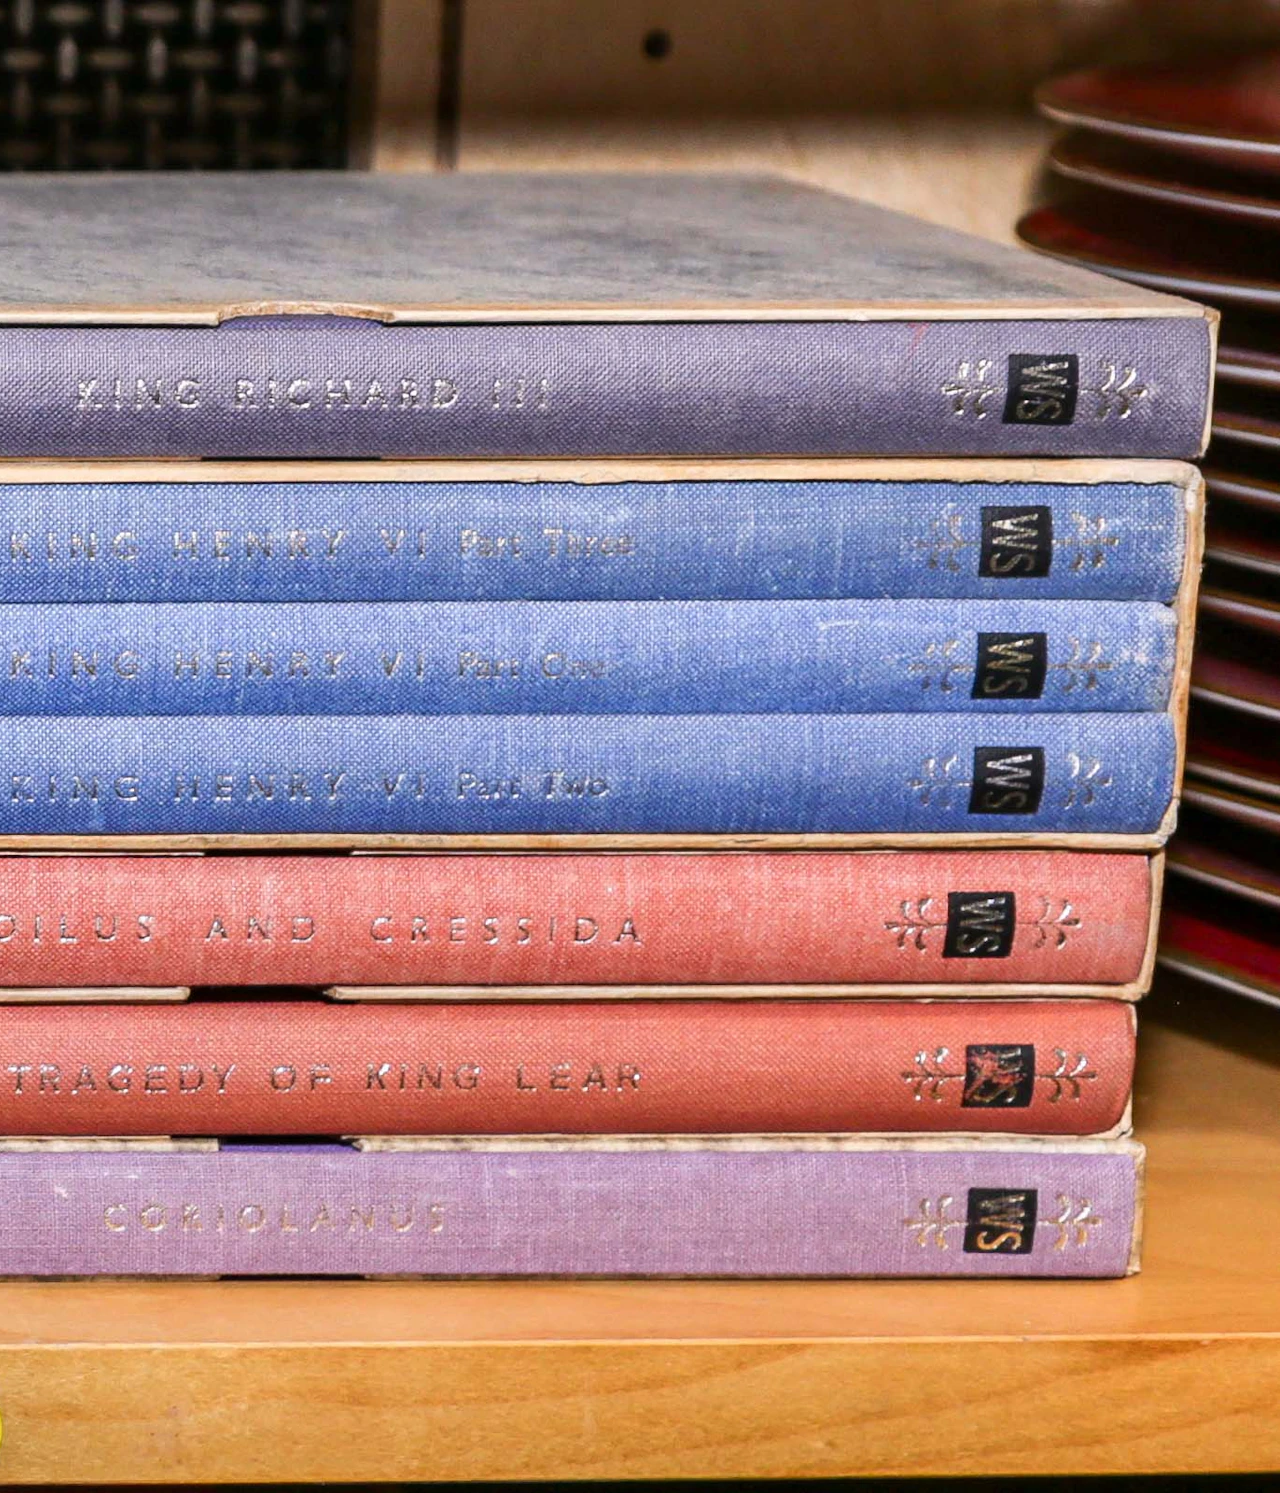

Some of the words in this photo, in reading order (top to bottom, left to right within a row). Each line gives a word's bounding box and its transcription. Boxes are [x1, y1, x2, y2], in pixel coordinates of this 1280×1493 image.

[77, 379, 202, 410] KING
[235, 378, 460, 409] RICHARD
[491, 378, 551, 408] III
[1014, 359, 1070, 421] WS
[10, 531, 138, 561] KING
[172, 528, 345, 560] HENRY
[381, 529, 427, 558] VI
[459, 528, 521, 558] Part
[544, 528, 635, 557] Three
[988, 511, 1041, 575] WS
[10, 650, 139, 680] KING
[175, 650, 345, 679] HENRY
[381, 650, 427, 678] VI
[458, 650, 519, 678] Part
[982, 636, 1036, 695] WS
[11, 775, 139, 803] KING
[175, 772, 345, 802] HENRY
[383, 773, 426, 799] VI
[458, 772, 521, 799] Part
[545, 771, 609, 798] Two
[983, 752, 1035, 813] WS
[205, 914, 316, 943] AND
[369, 916, 642, 945] CRESSIDA
[955, 896, 1007, 955] WS
[7, 1063, 235, 1095] TRAGEDY
[269, 1064, 332, 1092] OF
[366, 1063, 481, 1093] KING
[516, 1062, 641, 1093] LEAR
[105, 1204, 444, 1232] CORIOLANUS
[975, 1192, 1028, 1253] WS
